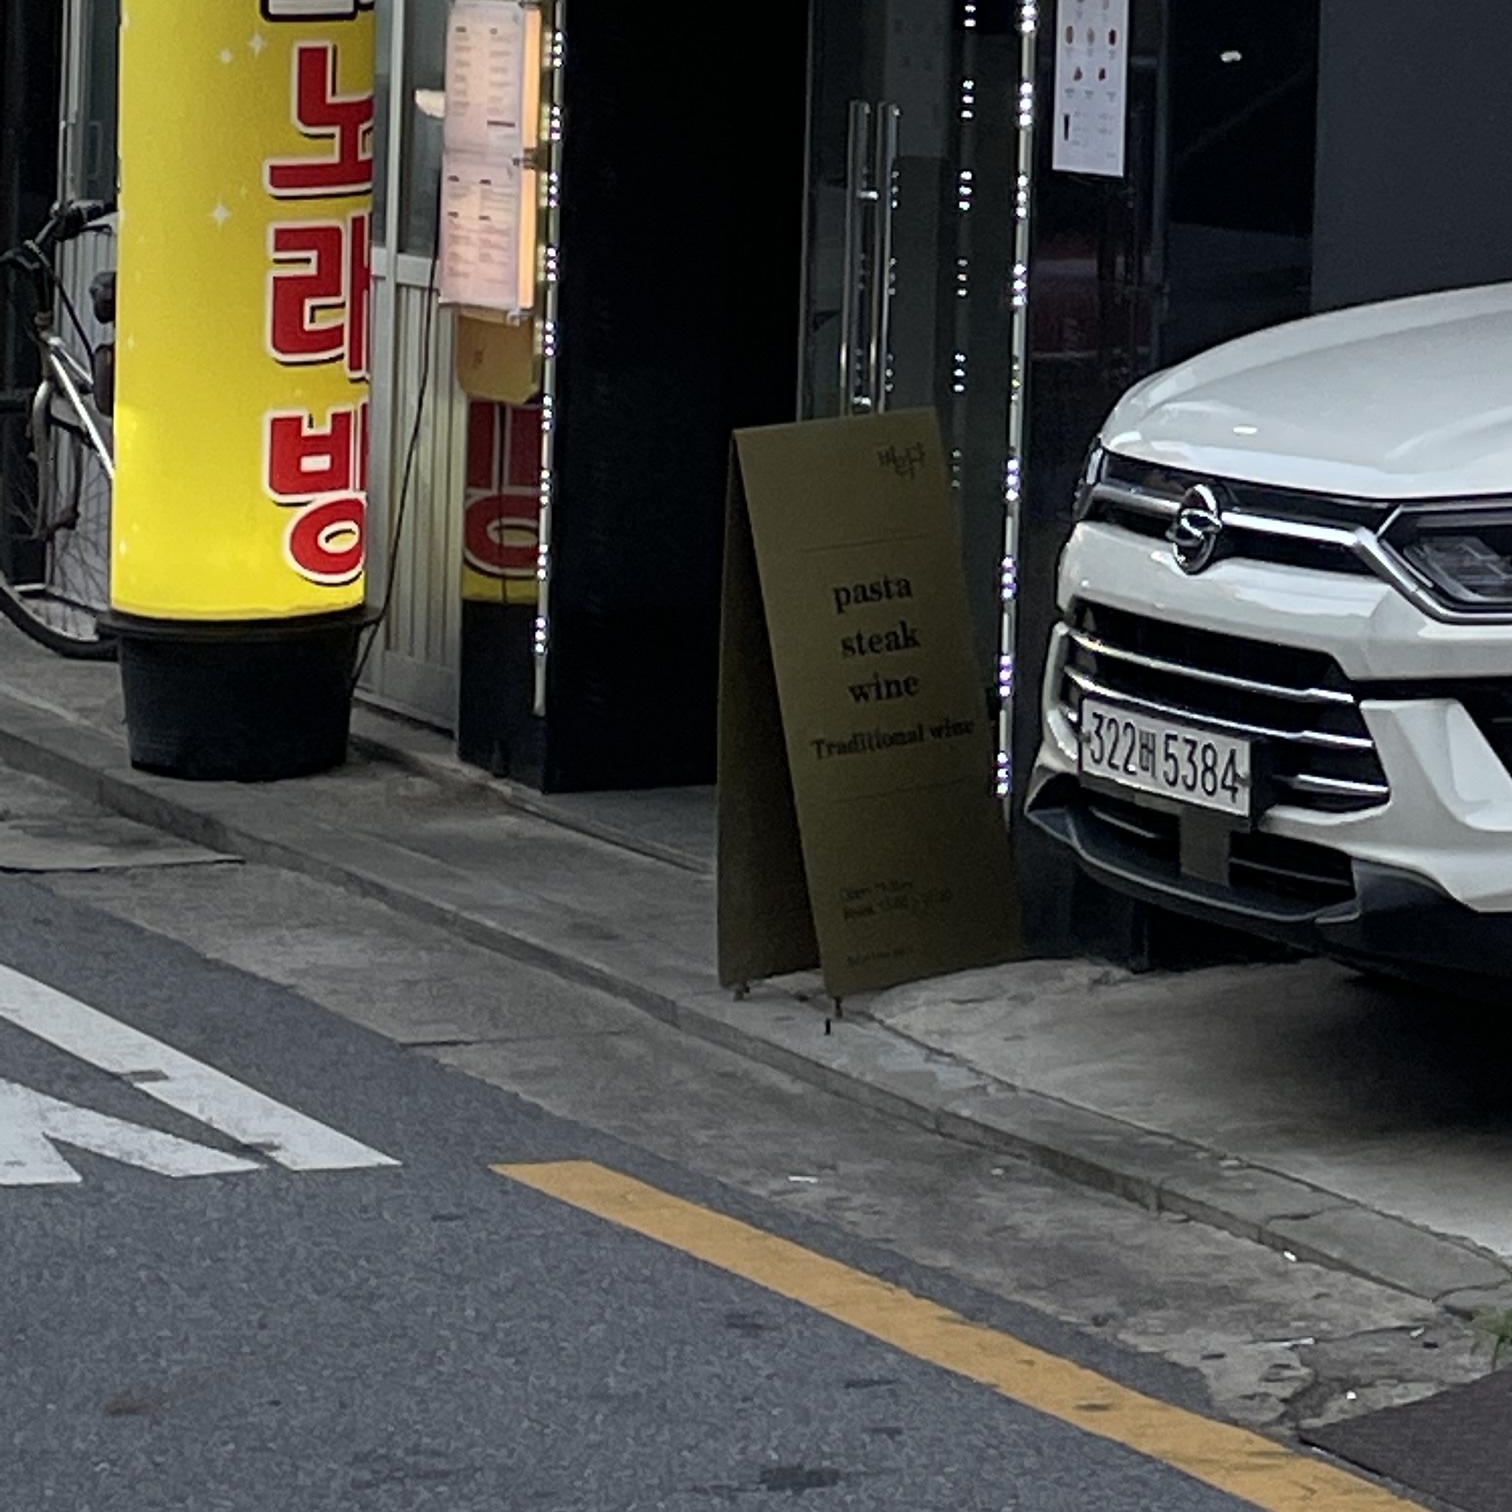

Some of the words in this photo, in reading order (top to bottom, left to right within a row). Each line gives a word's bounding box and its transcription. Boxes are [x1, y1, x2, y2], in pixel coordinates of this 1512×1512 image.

[832, 574, 912, 614] pasta
[841, 620, 922, 659] steak
[848, 672, 920, 704] wine
[811, 723, 925, 761] Traditional
[929, 717, 976, 742] wine
[1162, 733, 1240, 804] 5384
